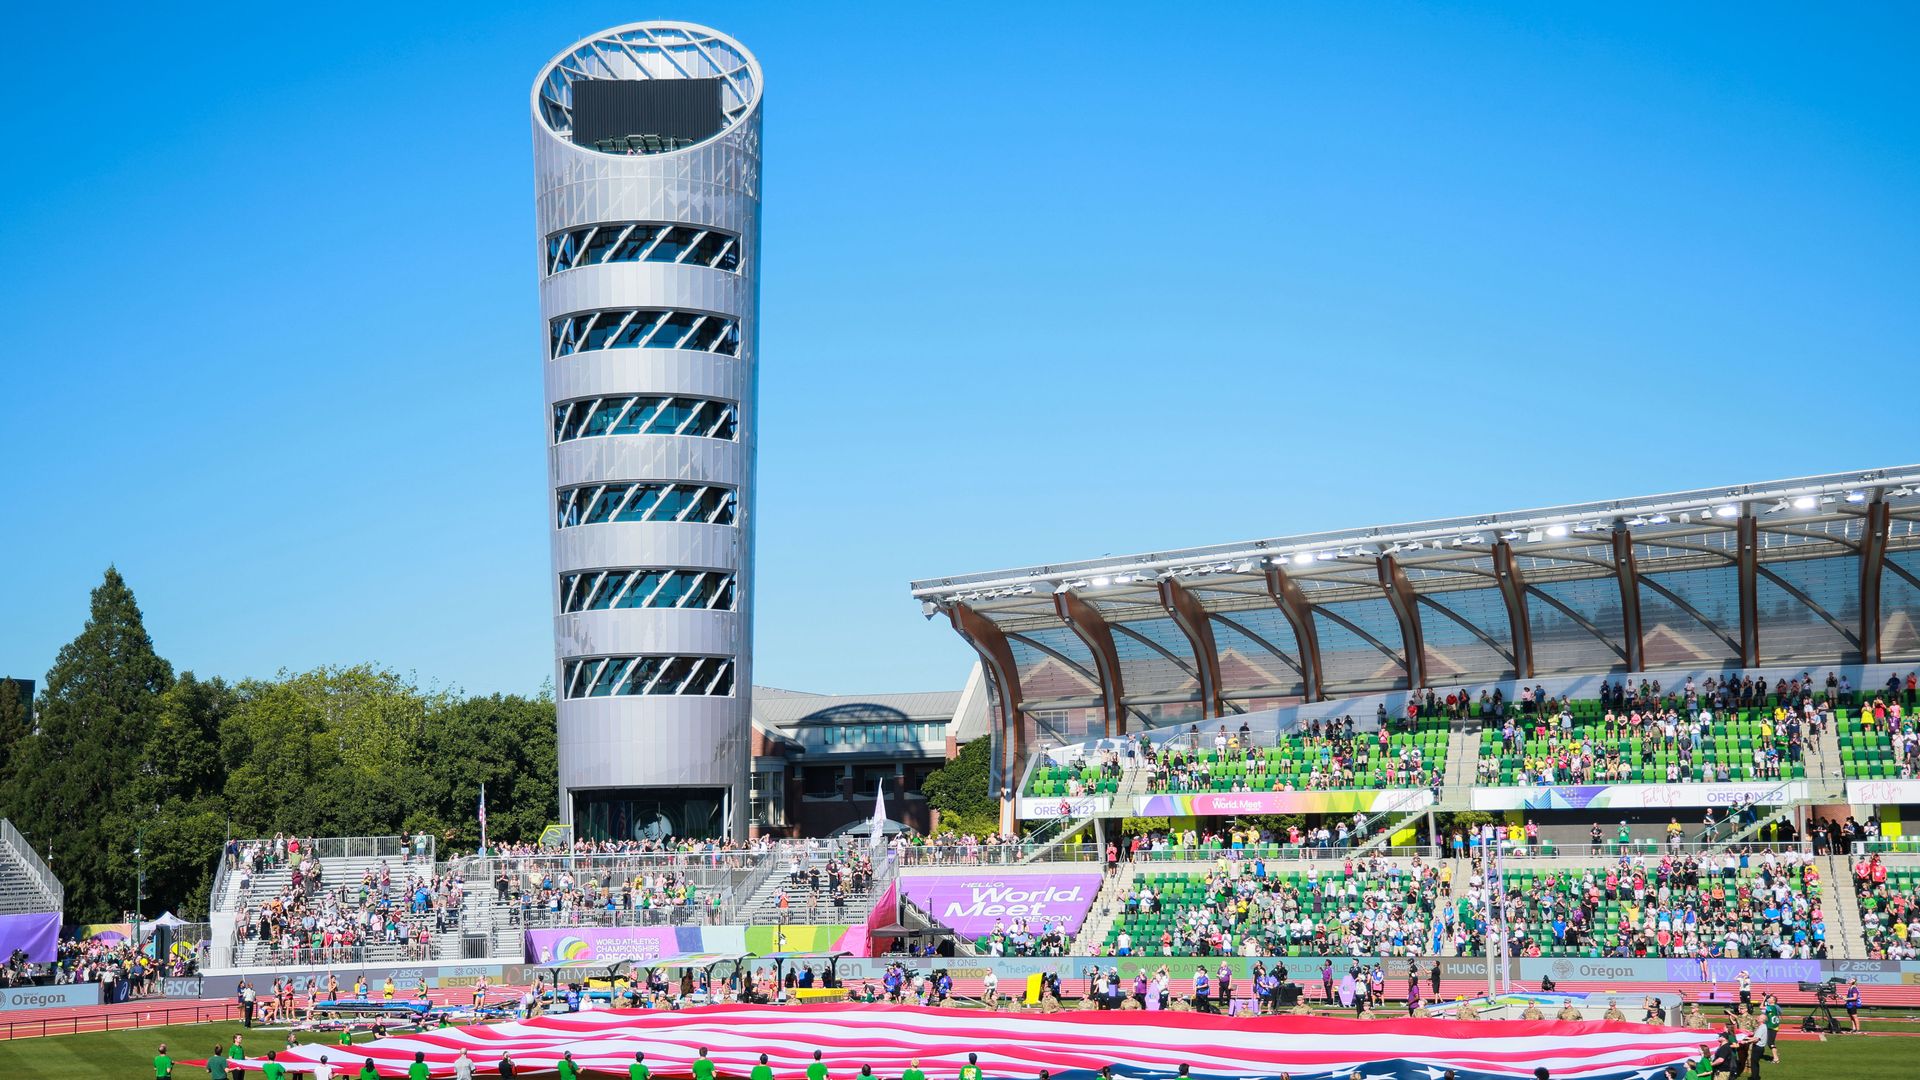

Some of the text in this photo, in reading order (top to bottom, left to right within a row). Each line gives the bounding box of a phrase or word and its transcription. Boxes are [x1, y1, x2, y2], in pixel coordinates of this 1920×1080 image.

[972, 886, 1084, 903] World.
[944, 902, 1046, 917] Meet
[596, 945, 660, 953] CHAMPIONSHIPS
[957, 959, 977, 967] QNB
[1447, 963, 1513, 974] HUNGR
[1852, 961, 1881, 971] asics
[400, 969, 423, 978] asics
[466, 967, 487, 975] QNB
[1580, 964, 1634, 979] Oregon
[1673, 960, 1736, 981] xfiity
[1748, 961, 1814, 982] xfinity
[166, 980, 204, 996] asics
[448, 977, 494, 987] SEIO
[12, 994, 66, 1007] Oregon
